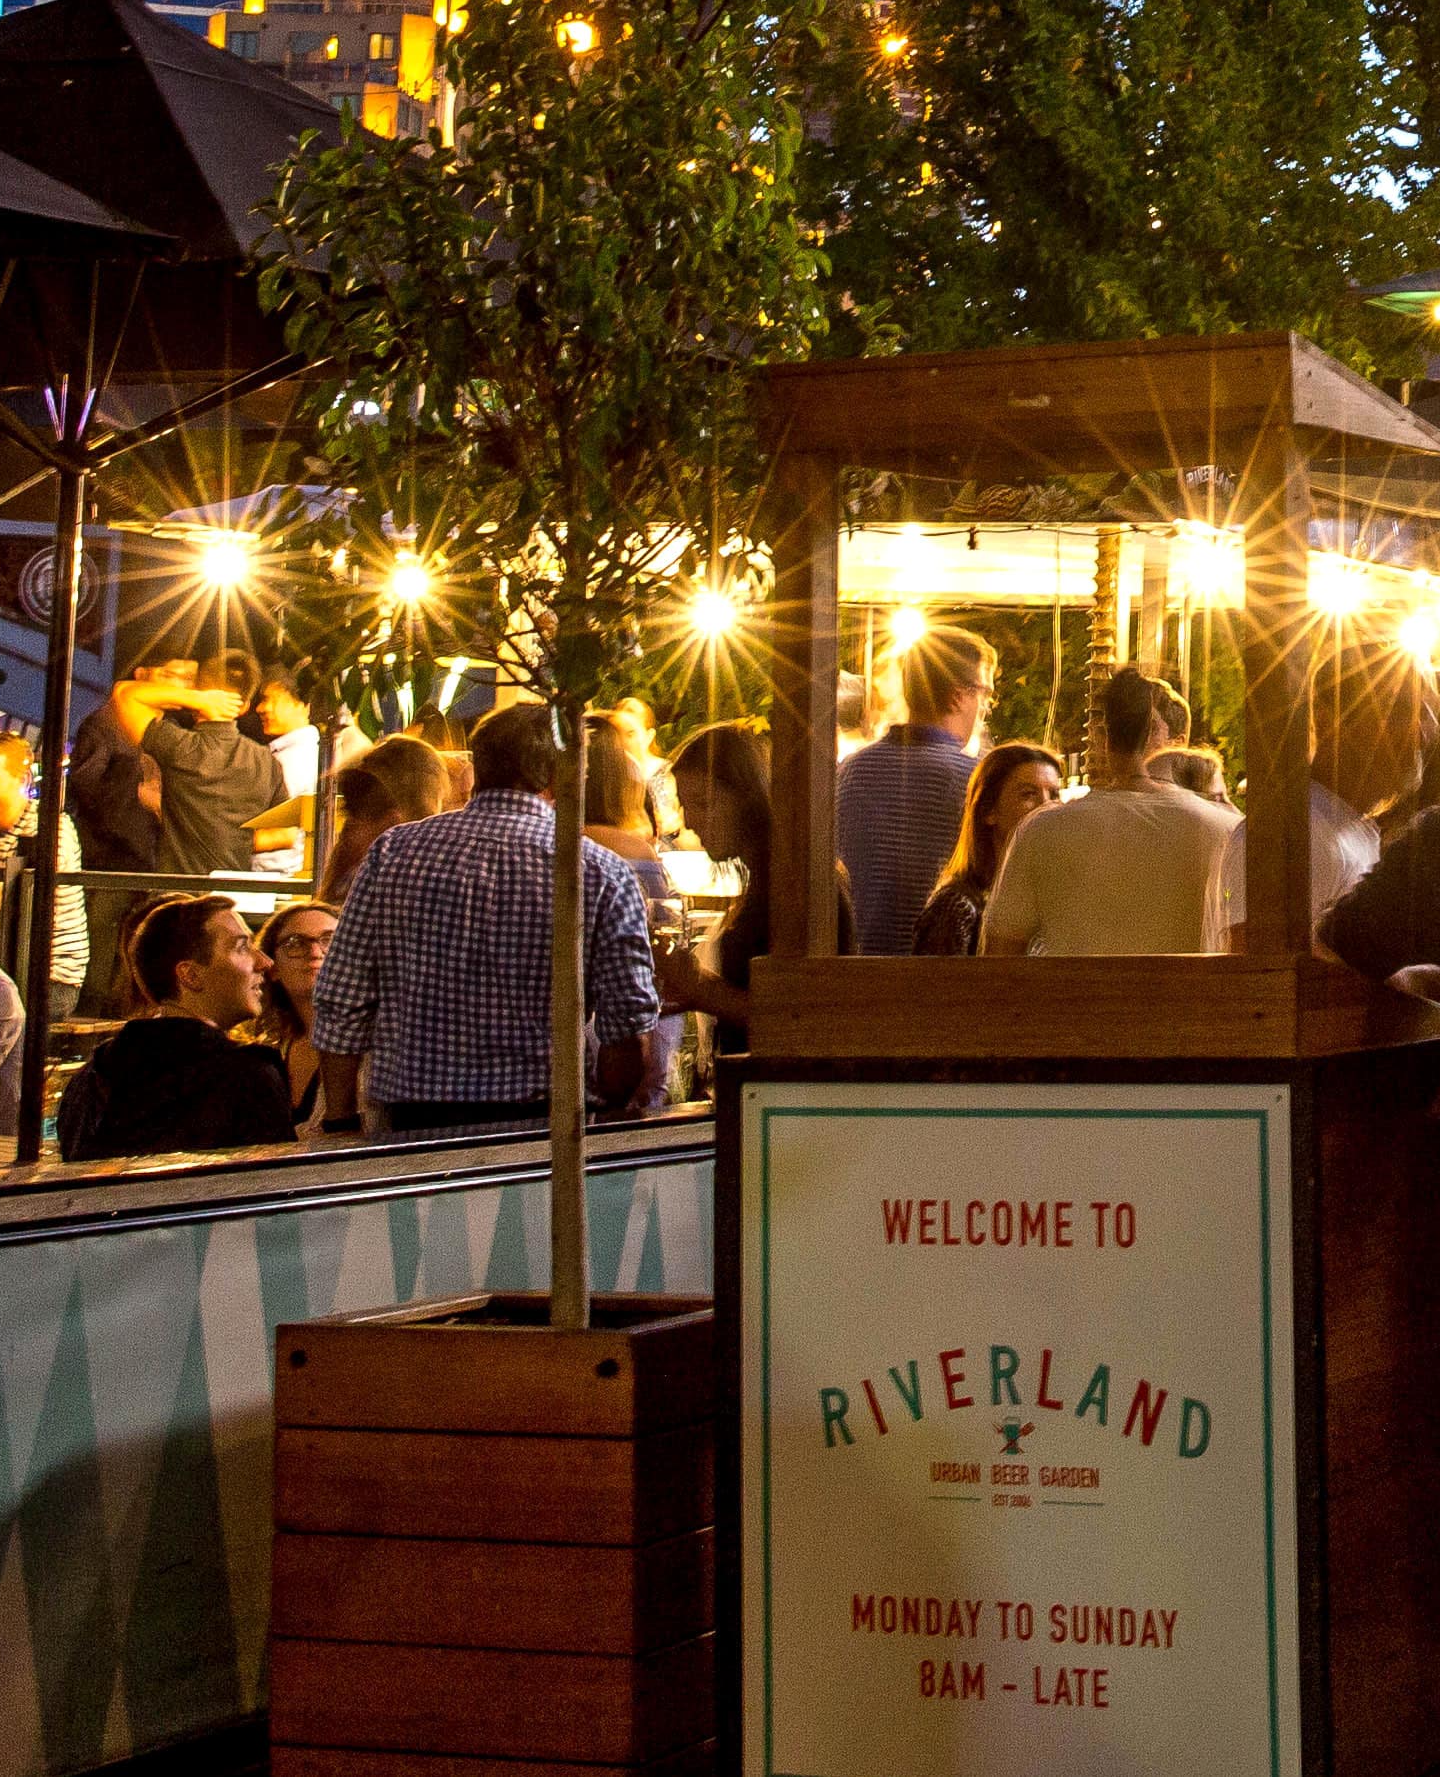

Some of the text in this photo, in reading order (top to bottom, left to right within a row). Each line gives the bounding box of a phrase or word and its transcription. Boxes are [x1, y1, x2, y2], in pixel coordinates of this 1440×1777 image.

[881, 1198, 1136, 1249] WELCOME TO
[819, 1344, 1212, 1459] RIVERLAND
[929, 1461, 1100, 1489] URBAN BEER GARDEN
[851, 1593, 1178, 1648] MONDAY TO SUNDAY
[920, 1660, 986, 1700] 8AM
[1033, 1665, 1109, 1709] LATE
